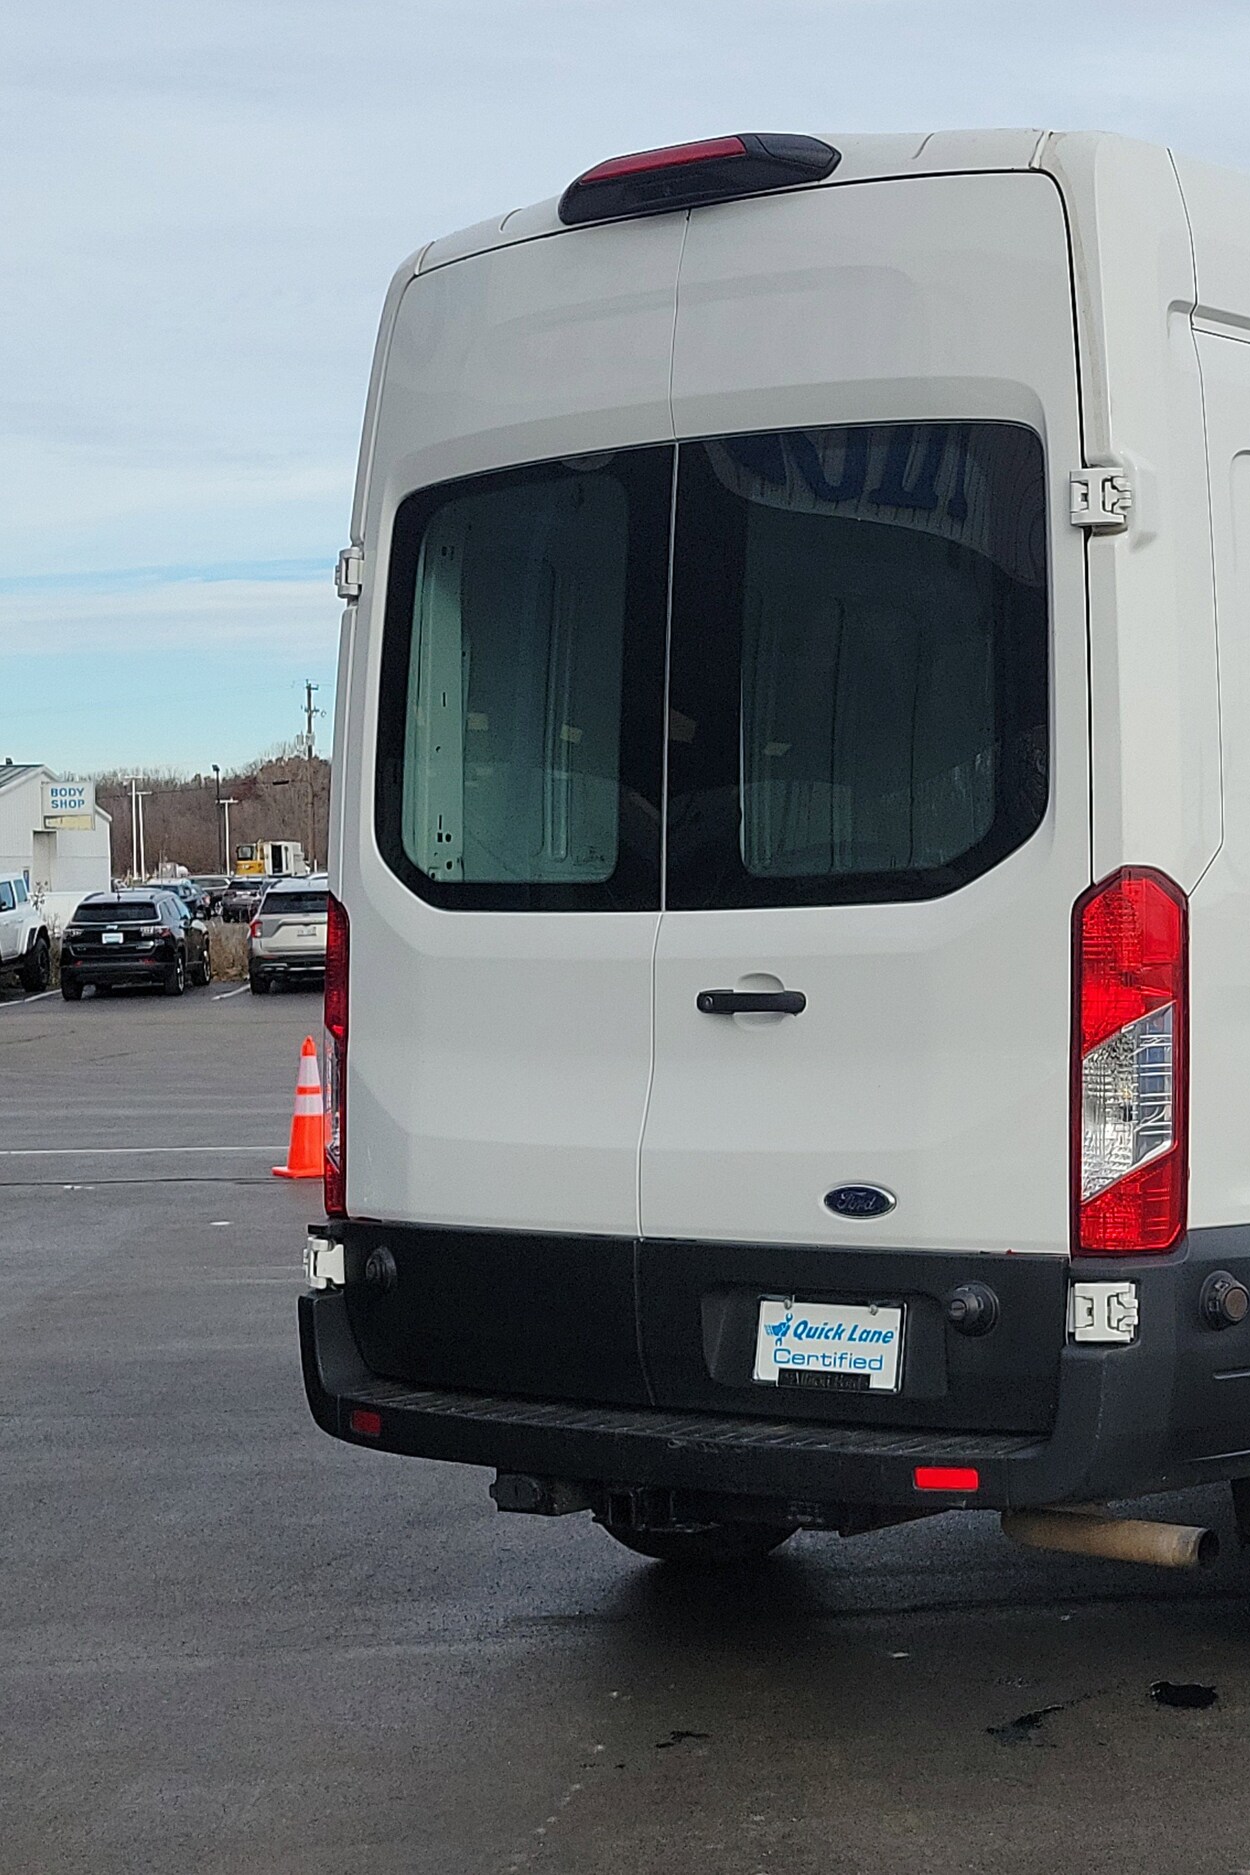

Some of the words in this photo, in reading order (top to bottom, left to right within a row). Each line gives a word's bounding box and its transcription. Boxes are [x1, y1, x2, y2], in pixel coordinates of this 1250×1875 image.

[51, 787, 85, 797] BODY
[51, 799, 85, 808] SHOP
[836, 1190, 876, 1210] Ford
[793, 1320, 845, 1341] Quick
[847, 1324, 894, 1344] Lane
[774, 1348, 883, 1370] Certified
